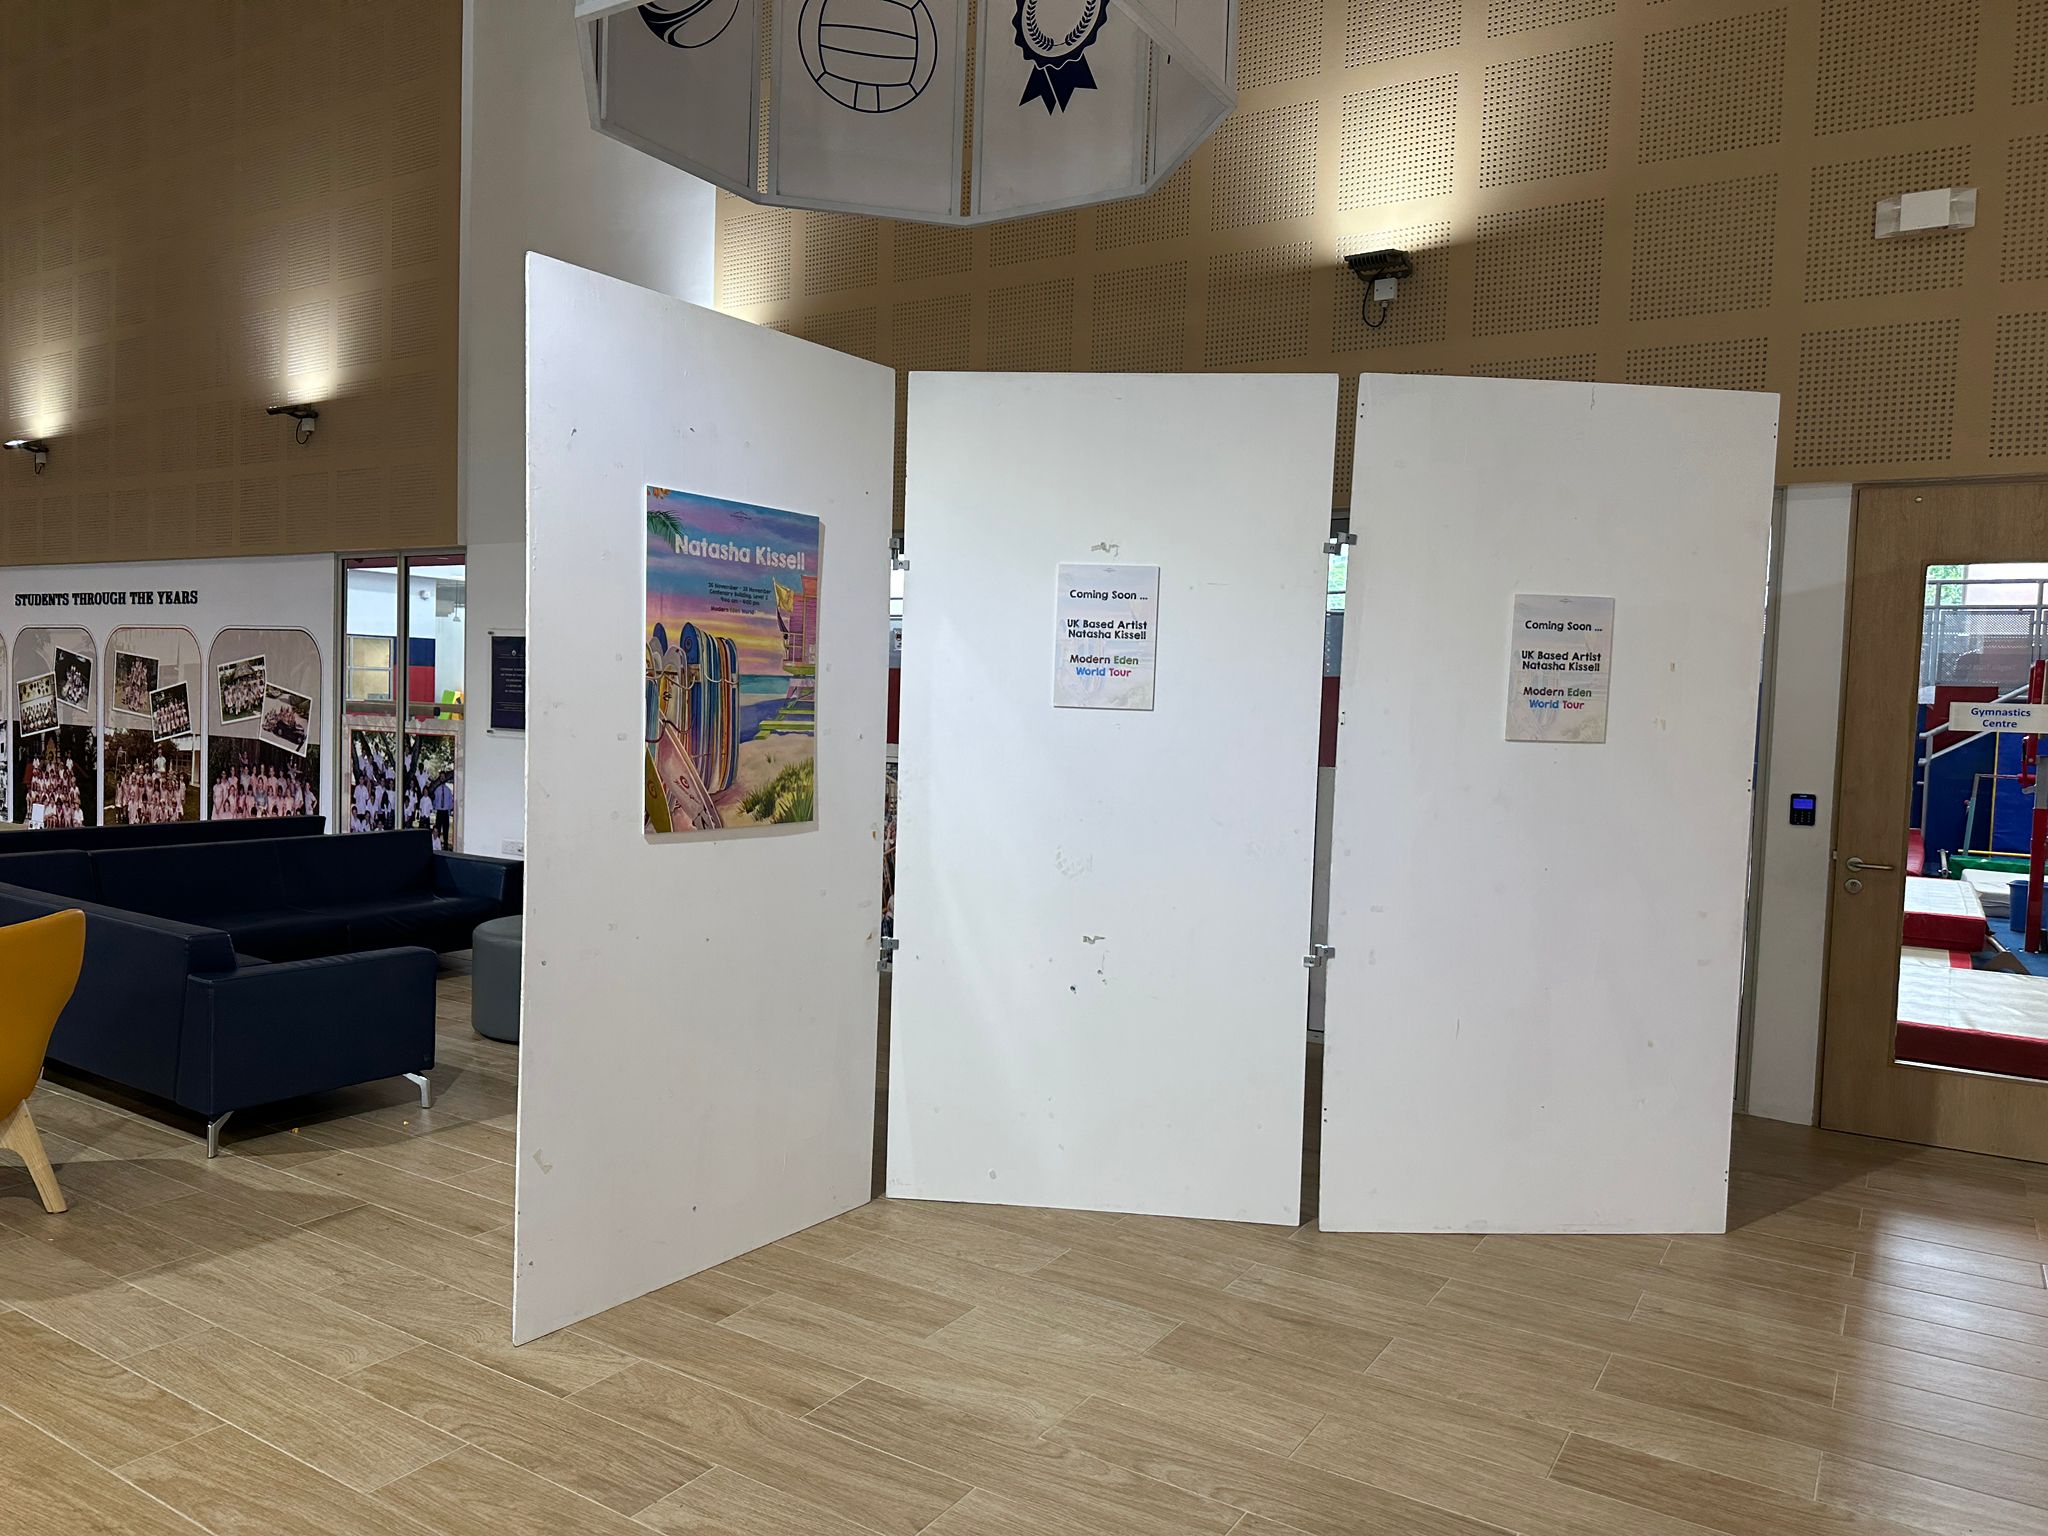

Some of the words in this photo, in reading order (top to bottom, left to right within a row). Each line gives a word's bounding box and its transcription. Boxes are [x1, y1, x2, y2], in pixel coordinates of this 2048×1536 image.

[675, 534, 750, 564] Natasha
[756, 546, 805, 570] Kissell
[15, 593, 69, 606] STUDENTS
[72, 592, 126, 606] THROUGH
[130, 591, 154, 605] THE
[157, 590, 198, 605] YEARS
[1070, 590, 1108, 600] Coming
[1112, 590, 1137, 600] Soon
[1067, 619, 1079, 628] UK
[1083, 620, 1114, 629] Based
[1118, 621, 1147, 630] Artist
[1525, 620, 1564, 632] Coming
[1567, 622, 1592, 631] Soon
[1068, 630, 1111, 639] Natasha
[1114, 631, 1146, 640] Kissell
[1070, 654, 1110, 664] Modern
[1114, 656, 1139, 665] Eden
[1522, 650, 1534, 660] UK
[1538, 651, 1568, 660] Based
[1572, 652, 1601, 662] Artist
[1522, 661, 1565, 671] Natasha
[1569, 662, 1600, 672] Kissell
[1076, 667, 1106, 676] World
[1109, 668, 1132, 677] Tour
[1523, 687, 1564, 696] Modern
[1567, 688, 1592, 697] Eden
[1529, 699, 1559, 709] World
[1562, 701, 1585, 709] Tour
[1971, 708, 2031, 717] Gymnastics
[1983, 720, 2018, 728] Centre
